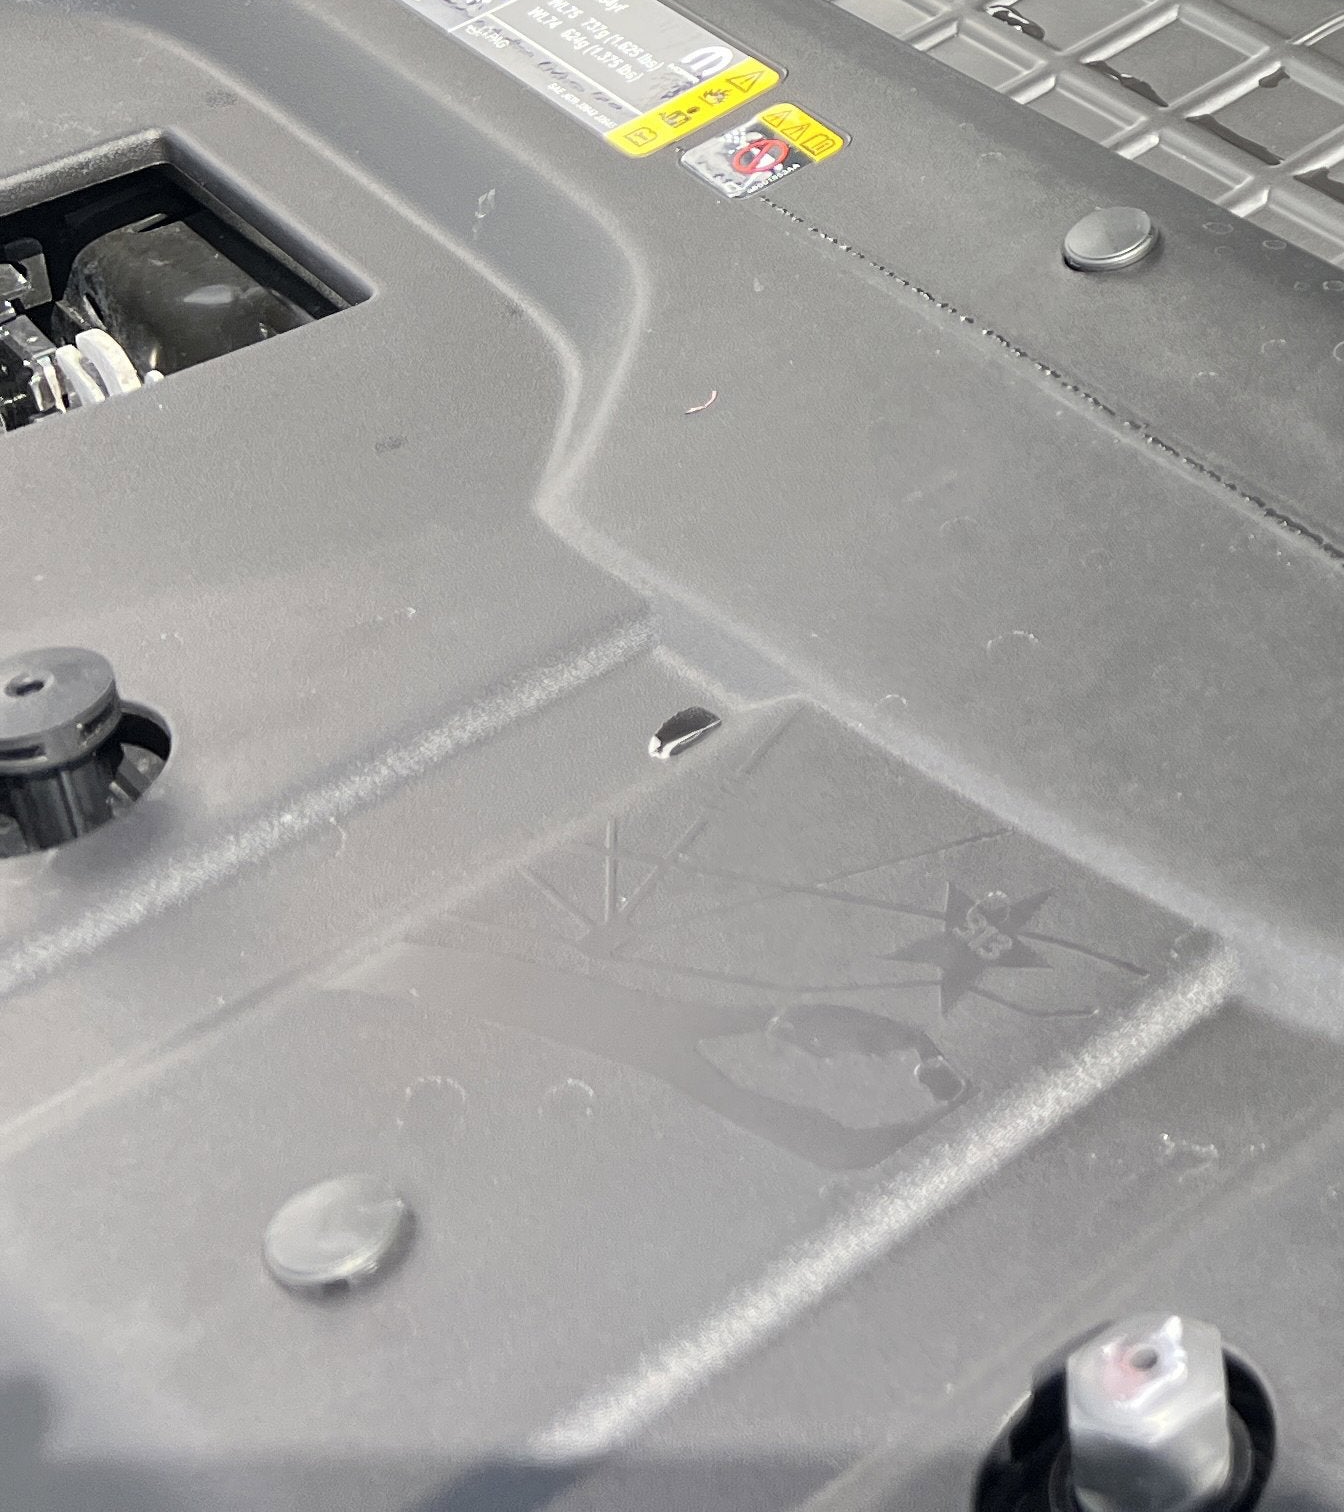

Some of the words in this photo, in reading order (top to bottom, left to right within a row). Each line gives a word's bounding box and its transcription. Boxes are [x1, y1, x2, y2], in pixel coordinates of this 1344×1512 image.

[527, 6, 563, 29] WL74
[582, 44, 625, 68] (1.375
[616, 63, 644, 83] lbs)
[602, 33, 645, 58] (1.625
[637, 53, 665, 72] lbs)
